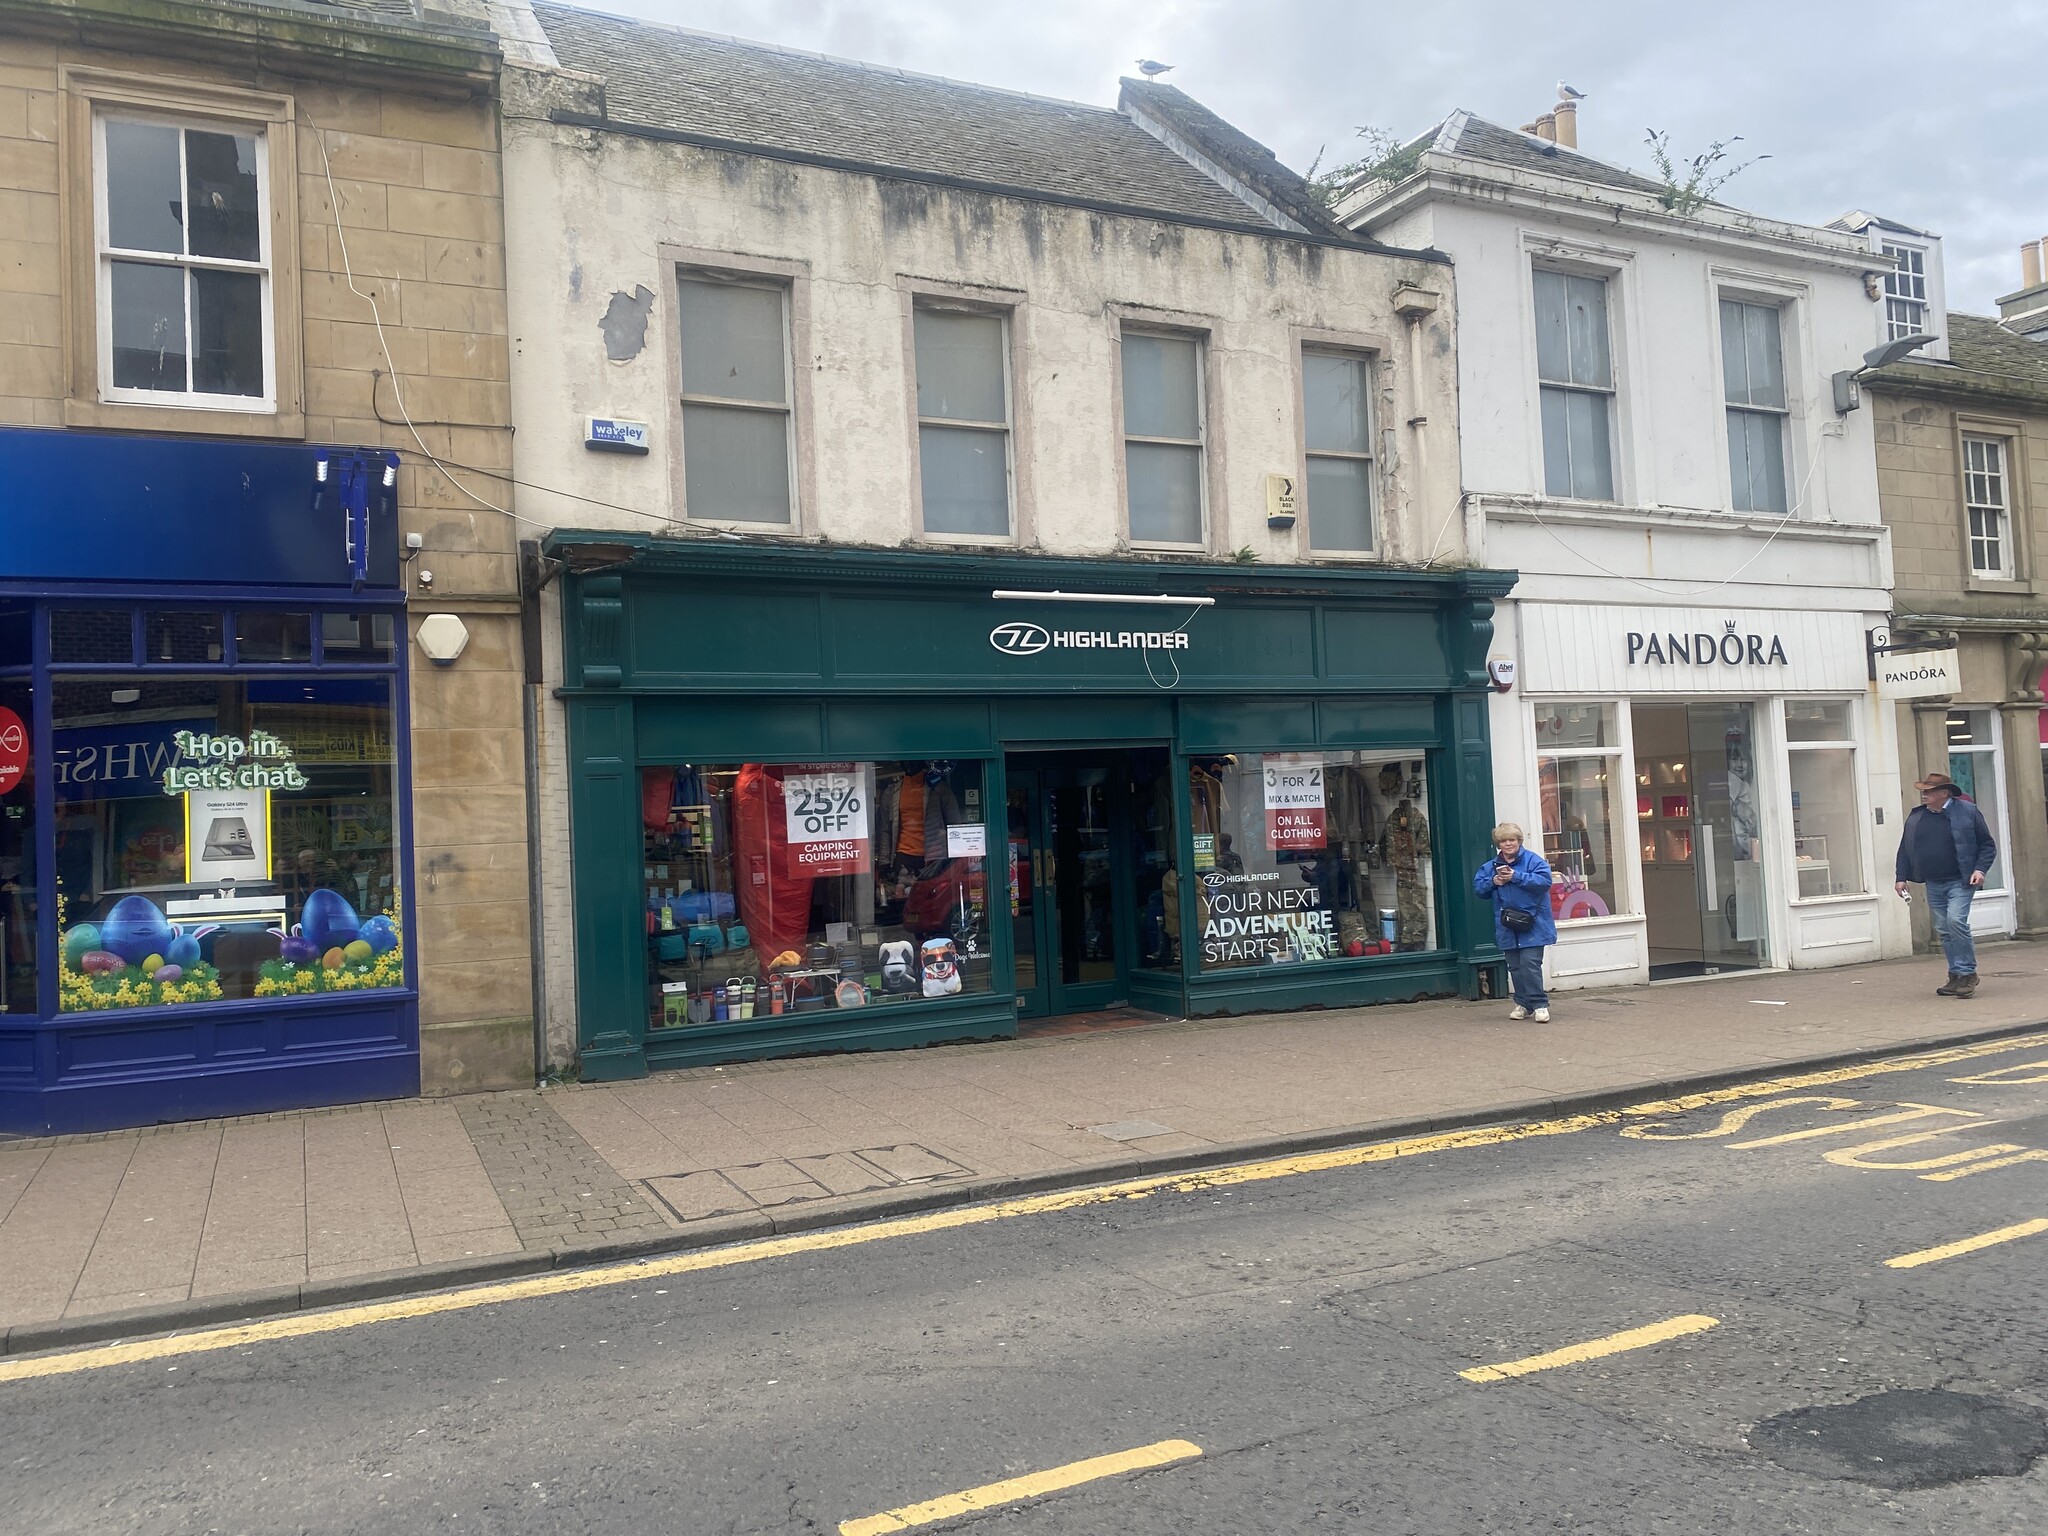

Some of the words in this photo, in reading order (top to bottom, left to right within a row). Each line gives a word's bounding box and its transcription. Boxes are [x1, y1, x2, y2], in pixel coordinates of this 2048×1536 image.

[1053, 630, 1189, 649] HIGHLANDER
[1626, 631, 1788, 666] PANDORA
[1885, 667, 1946, 684] PANDORA
[189, 736, 244, 761] Hop
[170, 766, 232, 788] Let's
[1266, 768, 1277, 787] 3
[1282, 776, 1305, 787] FOR
[1309, 767, 1321, 787] 2
[793, 786, 861, 816] 25%
[1268, 795, 1282, 803] MIX
[1284, 795, 1290, 803] &
[1292, 794, 1320, 803] MATCH
[804, 814, 849, 834] OFF
[1277, 816, 1291, 825] ON
[1294, 815, 1313, 825] ALL
[1270, 828, 1321, 839] CLOTHING
[804, 841, 853, 853] CAMPING
[1194, 840, 1213, 849] GIFT
[799, 850, 860, 862] EQUIPMENT
[1226, 872, 1280, 883] HIGHLANDER
[1201, 892, 1262, 914] YOUR
[1267, 888, 1319, 910] NEXT
[1203, 909, 1333, 939] ADVENTURE
[1205, 937, 1280, 963] STARTS
[1285, 932, 1340, 955] HERE
[953, 953, 968, 964] Dogs
[968, 951, 991, 960] Welcome
